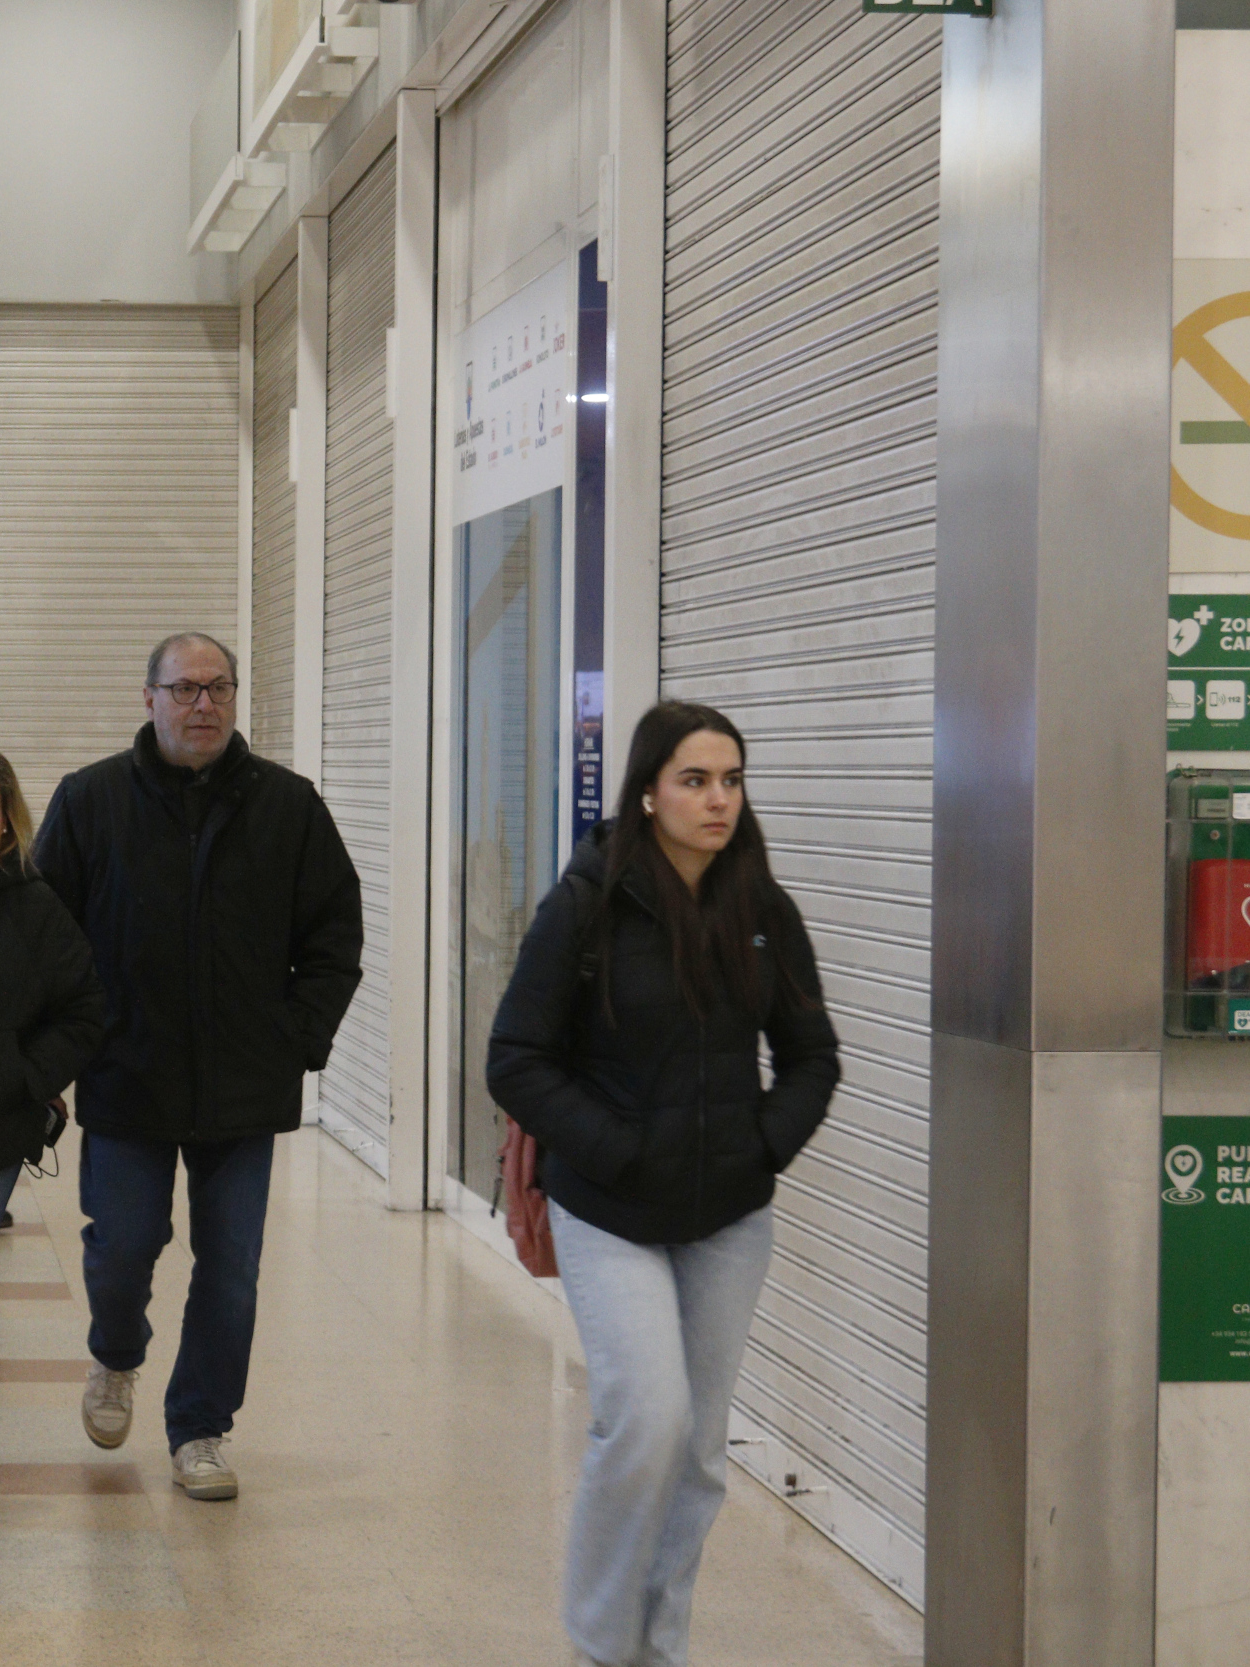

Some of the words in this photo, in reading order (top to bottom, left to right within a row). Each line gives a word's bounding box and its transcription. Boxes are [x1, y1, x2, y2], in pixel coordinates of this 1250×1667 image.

[1220, 618, 1250, 633] ZO
[1220, 636, 1250, 651] CA
[1217, 1145, 1250, 1162] PU
[1216, 1187, 1250, 1204] CA
